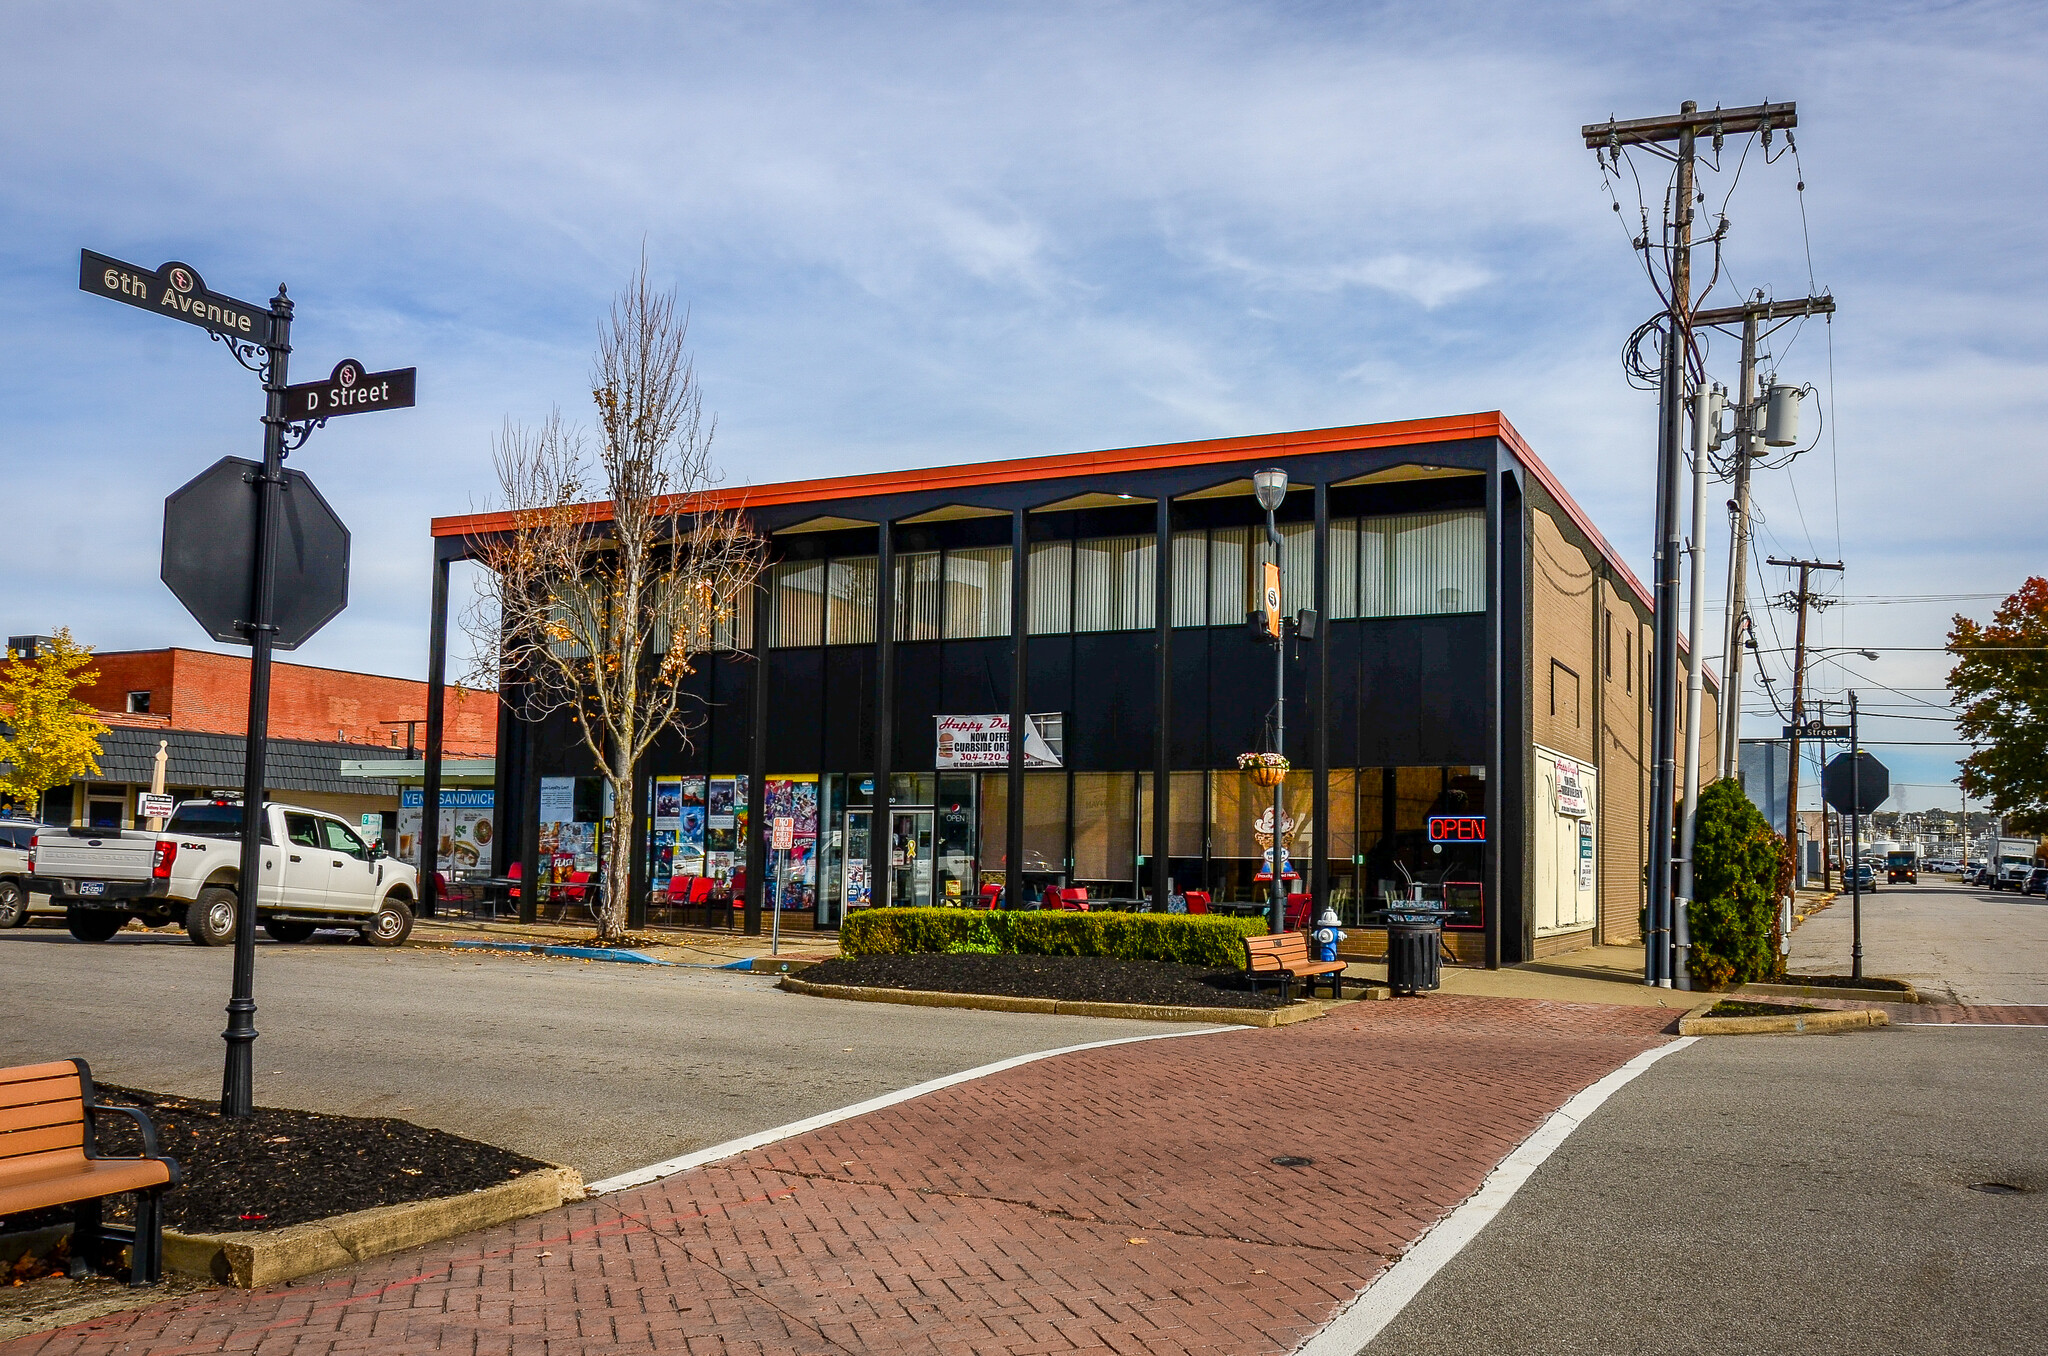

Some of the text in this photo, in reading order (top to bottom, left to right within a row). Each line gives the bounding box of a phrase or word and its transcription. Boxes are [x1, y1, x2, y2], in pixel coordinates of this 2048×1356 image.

[104, 269, 251, 332] 6th Avenue
[307, 382, 389, 410] D Street
[939, 717, 983, 732] Happy
[970, 733, 988, 742] NOW
[954, 743, 992, 752] CURBSIDE
[994, 743, 1005, 751] OR
[439, 793, 495, 805] SANDWICH
[363, 816, 368, 824] 2
[779, 818, 789, 827] NO
[1431, 819, 1485, 840] OPEN
[45, 851, 98, 860] SUPER
